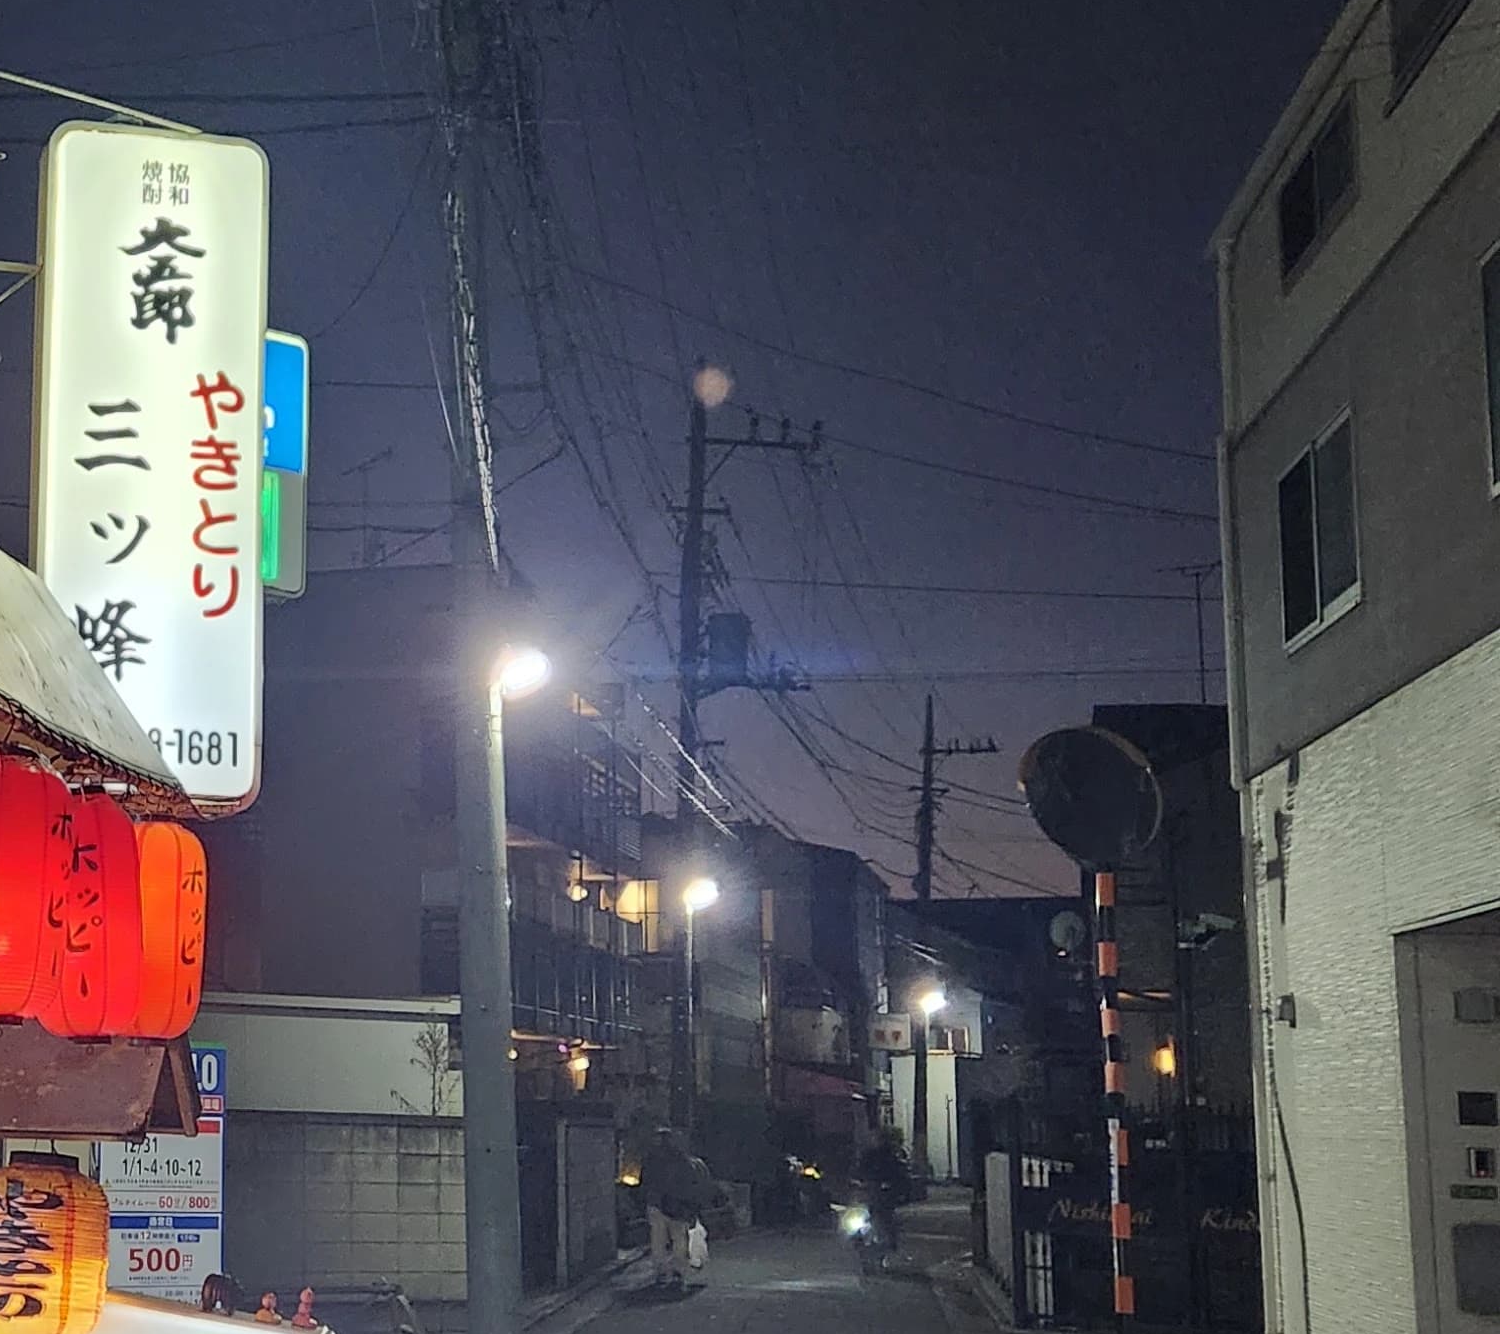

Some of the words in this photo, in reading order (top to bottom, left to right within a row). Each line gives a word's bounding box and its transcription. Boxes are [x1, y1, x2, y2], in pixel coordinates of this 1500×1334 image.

[75, 399, 153, 683] 三ツ峰
[190, 370, 244, 619] やきとり
[181, 860, 203, 1007] ホッピー
[128, 1247, 194, 1273] 500円
